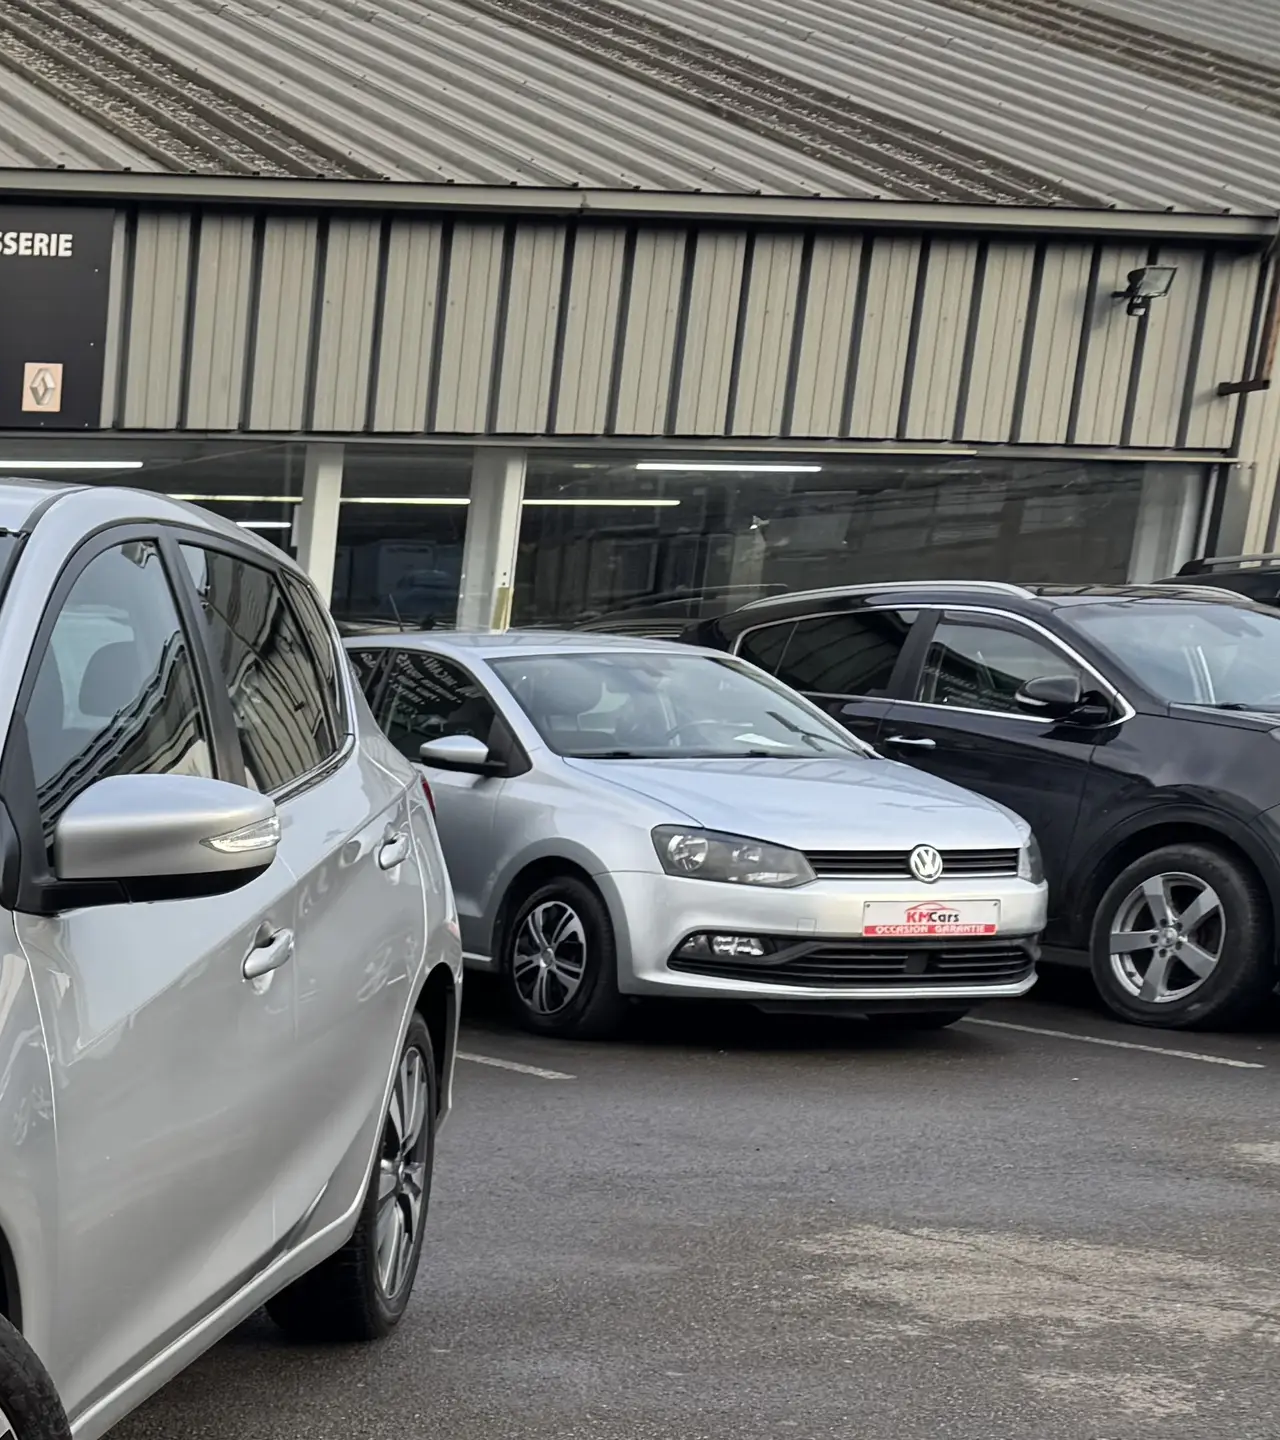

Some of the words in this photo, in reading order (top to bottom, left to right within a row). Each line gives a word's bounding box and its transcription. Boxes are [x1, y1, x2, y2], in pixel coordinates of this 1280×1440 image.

[906, 911, 960, 923] KMCars
[875, 925, 928, 934] OCCASION
[935, 925, 986, 933] GARANTIE
